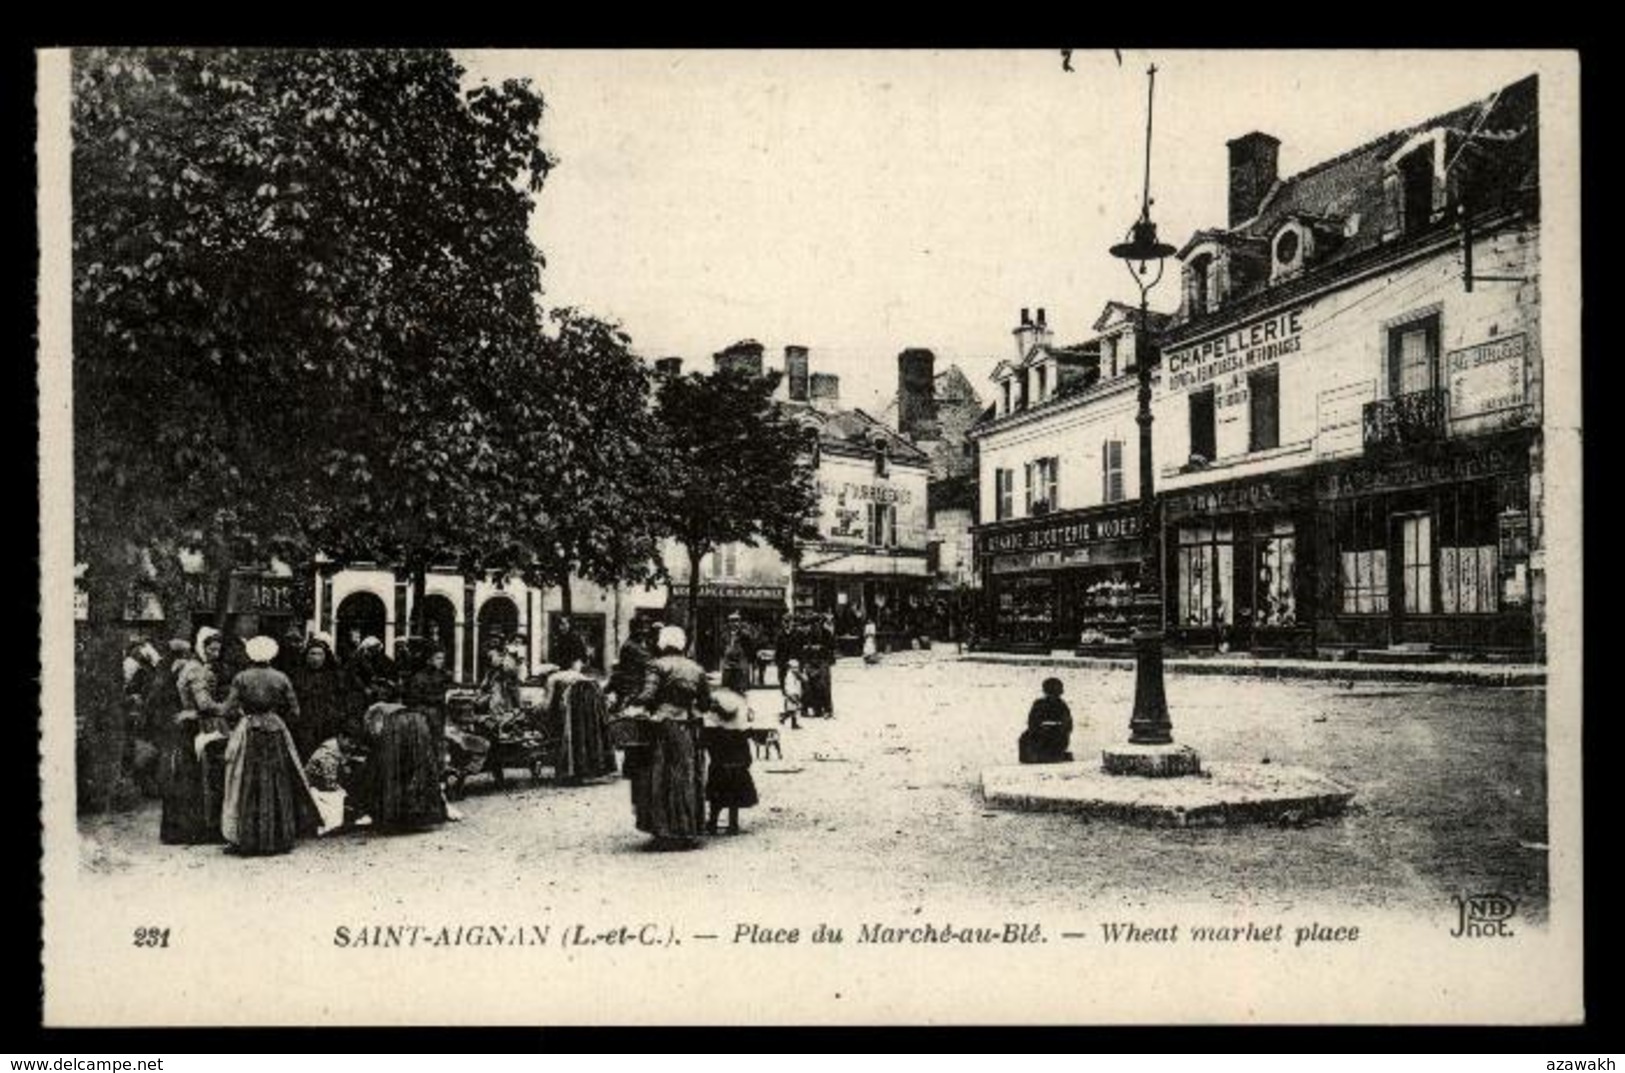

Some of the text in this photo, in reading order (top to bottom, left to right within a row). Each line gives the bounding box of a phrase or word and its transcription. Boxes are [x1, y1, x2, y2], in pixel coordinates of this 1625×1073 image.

[1169, 309, 1303, 373] CHAPELLERIE
[133, 927, 170, 948] 231
[333, 925, 551, 947] SAINT-AIGNAN
[733, 923, 801, 944] Place
[811, 924, 844, 944] du
[857, 922, 1048, 944] Marché-au-Blé.
[1102, 922, 1178, 943] Wheat
[1294, 922, 1360, 947] place
